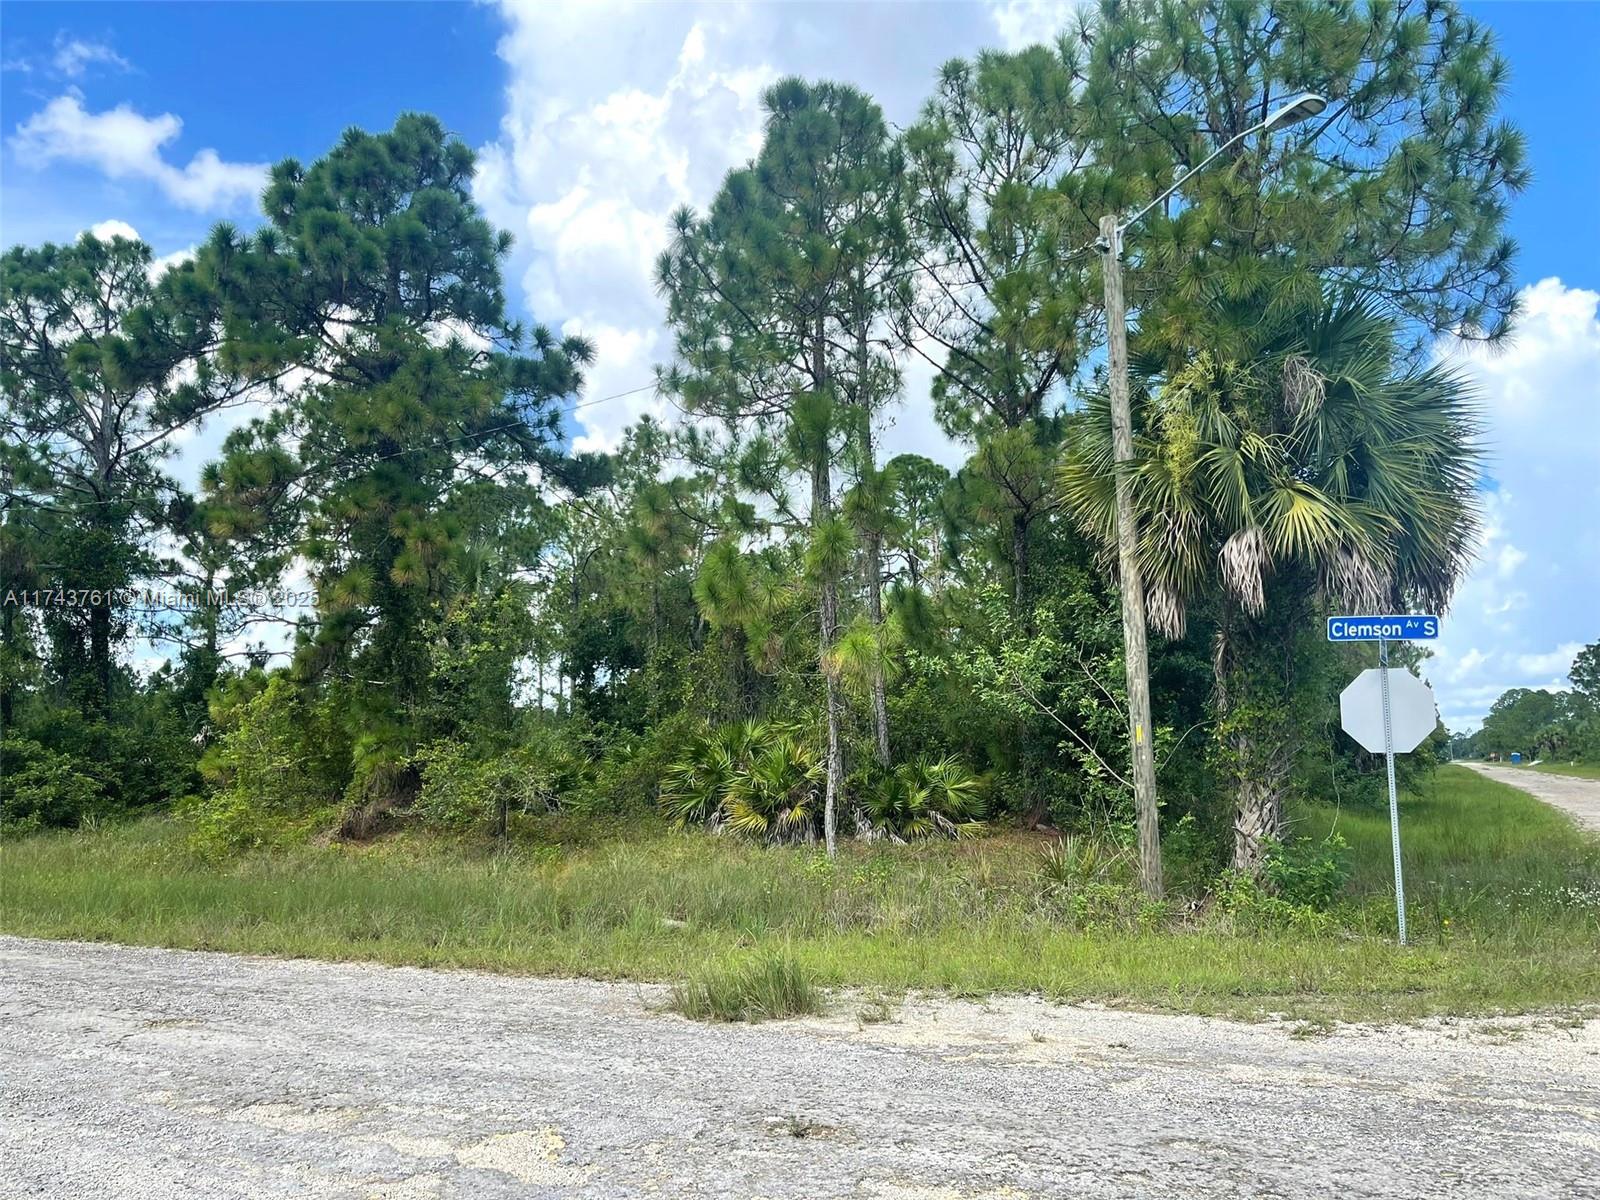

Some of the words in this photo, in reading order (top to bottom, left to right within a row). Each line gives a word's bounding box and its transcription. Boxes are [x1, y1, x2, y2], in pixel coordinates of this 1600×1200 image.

[1332, 622, 1402, 637] Clemson
[1405, 619, 1420, 629] Av
[1423, 620, 1436, 636] S
